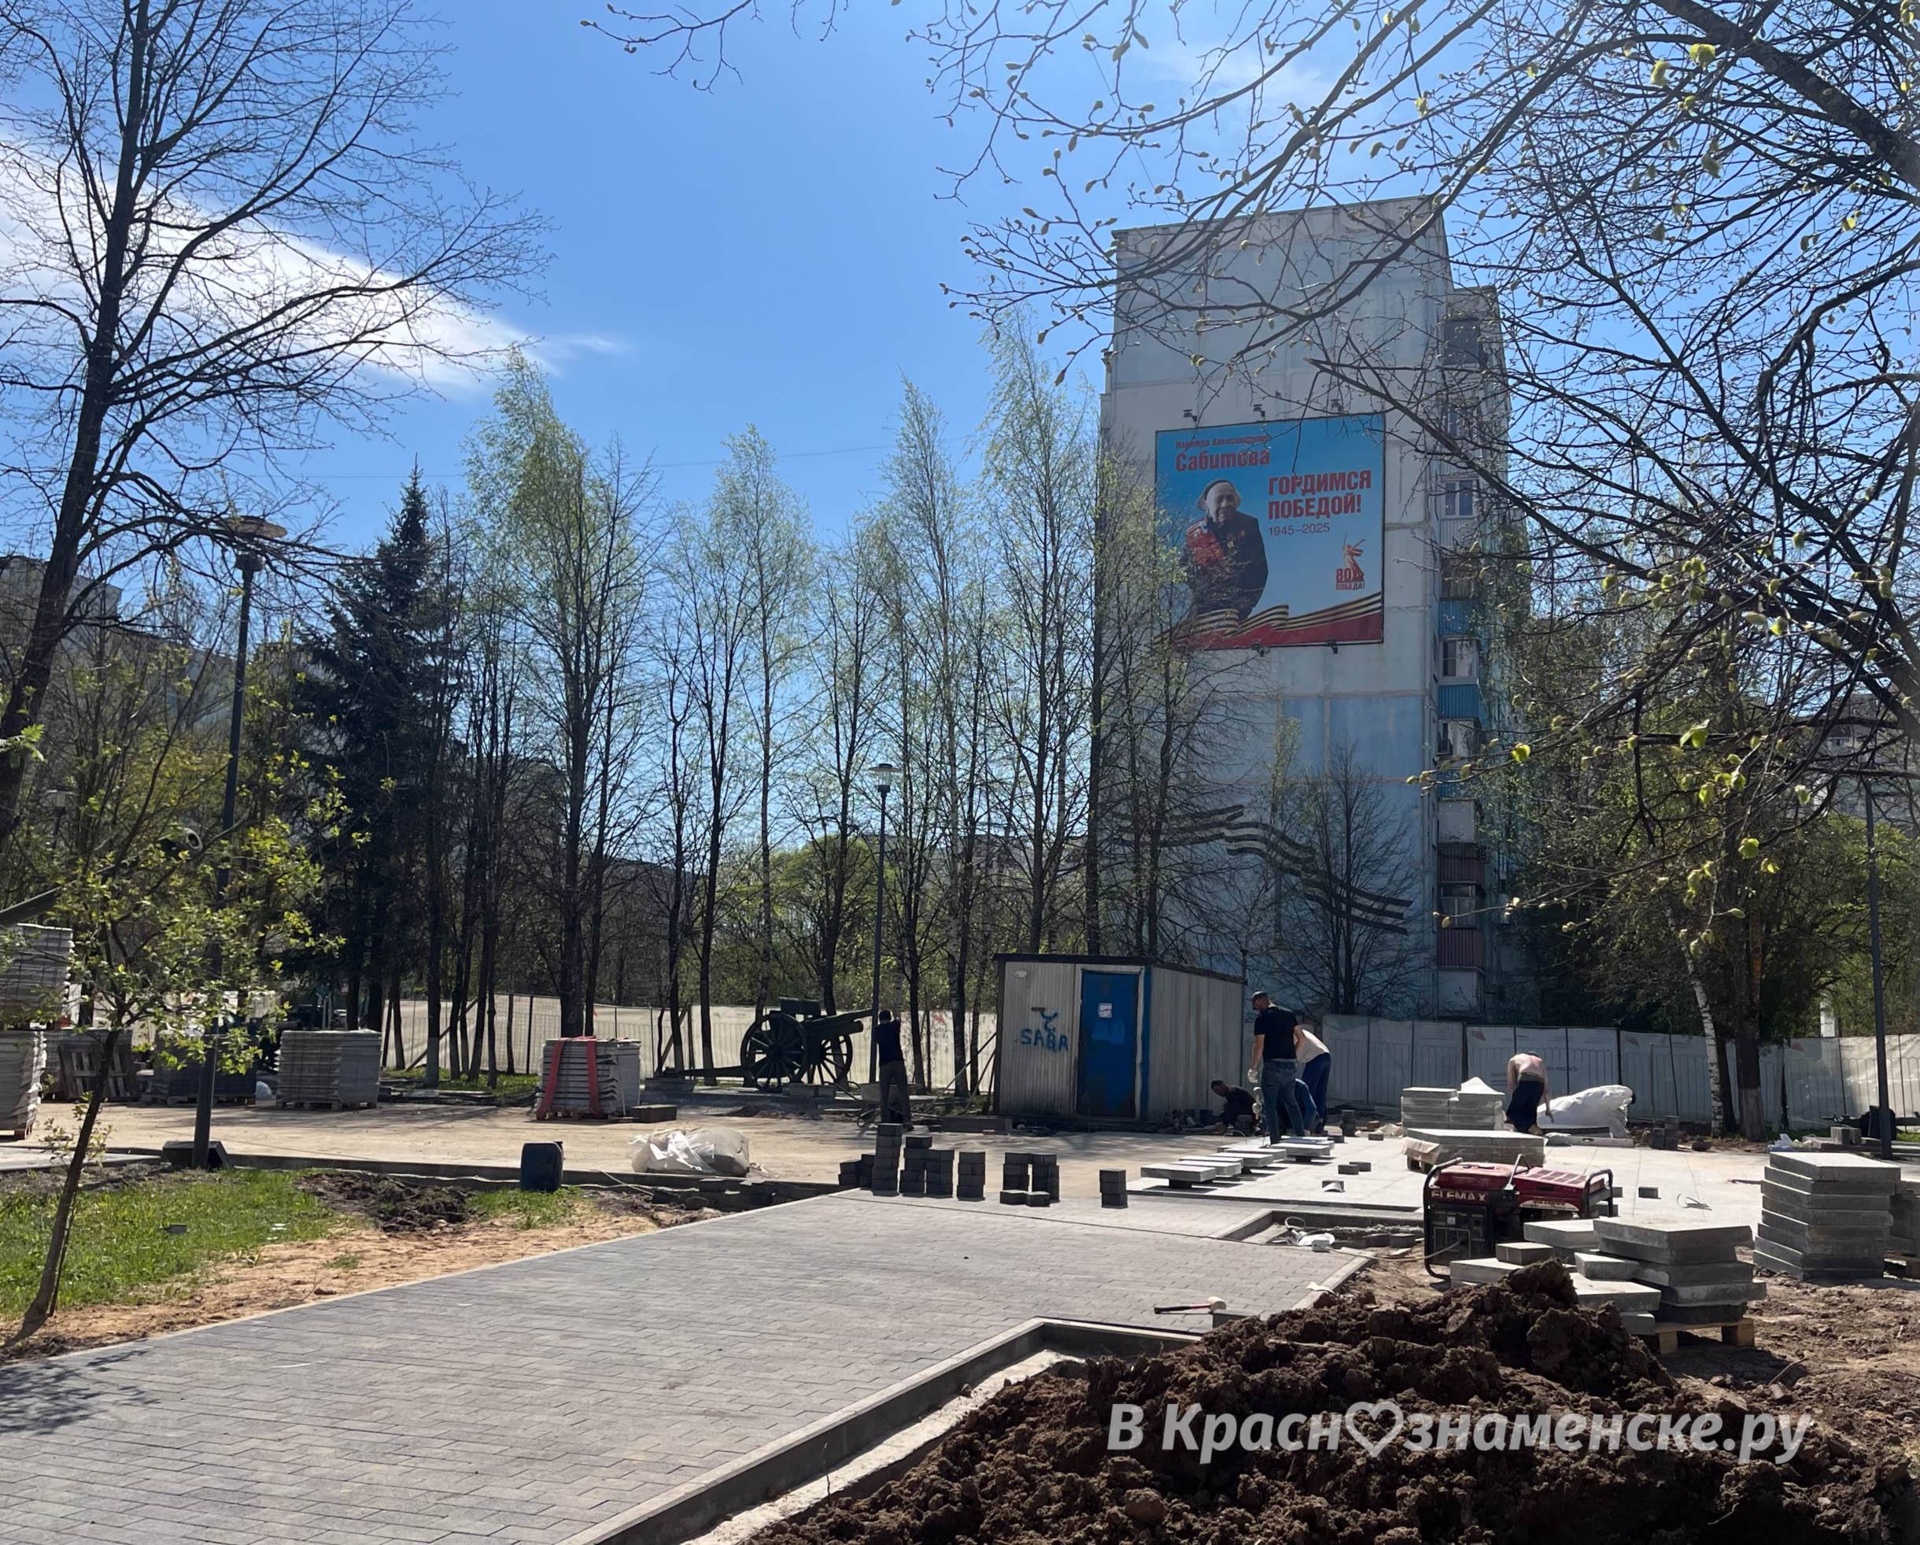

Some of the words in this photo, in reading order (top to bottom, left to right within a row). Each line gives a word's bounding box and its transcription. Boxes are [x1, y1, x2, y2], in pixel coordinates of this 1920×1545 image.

[1176, 450, 1270, 472] Сабитова
[1268, 470, 1372, 496] ГОРДИМСЯ
[1268, 492, 1362, 520] ПОБЕДОЙ!
[1336, 568, 1351, 582] 80
[1431, 1190, 1487, 1203] ELEMAX
